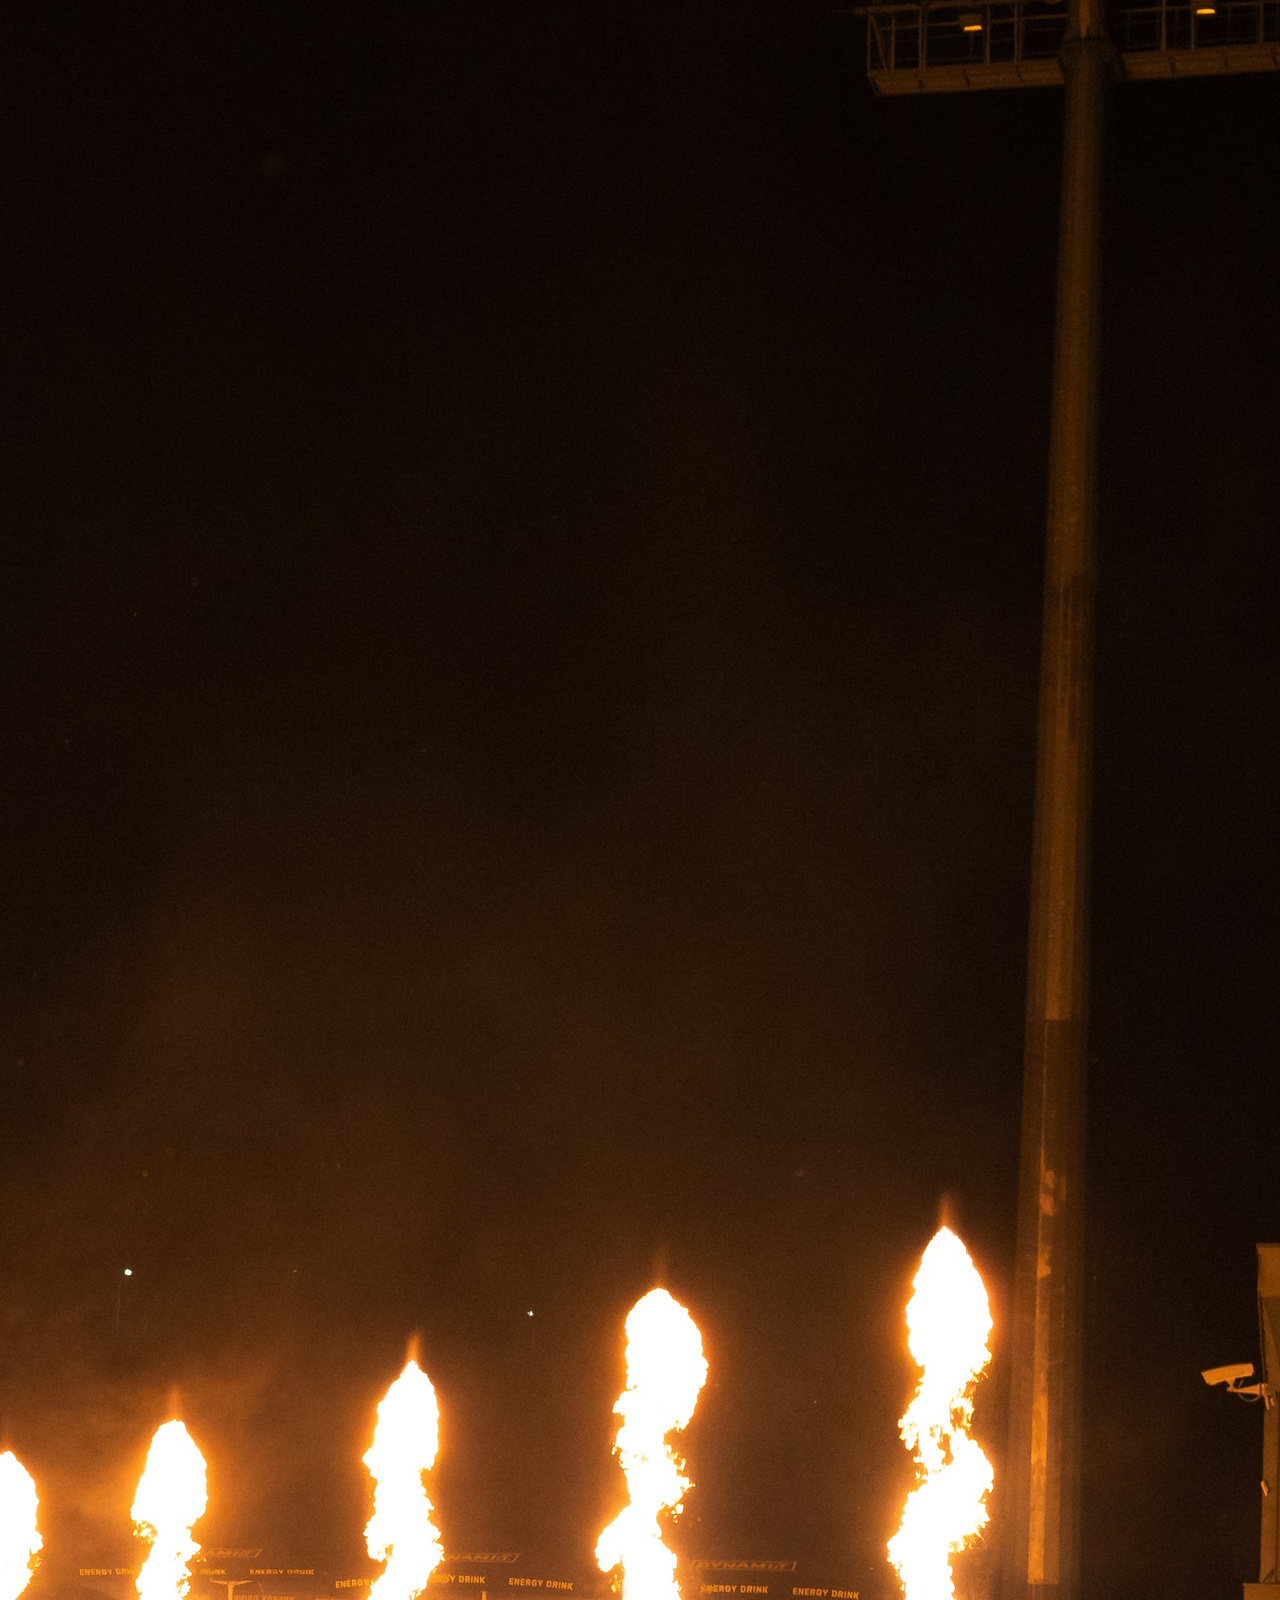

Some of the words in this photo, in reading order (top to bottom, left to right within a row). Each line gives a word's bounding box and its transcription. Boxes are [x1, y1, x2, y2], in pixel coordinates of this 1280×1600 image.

[79, 1568, 113, 1577] ENERGY
[458, 1575, 486, 1585] DRINK
[508, 1577, 544, 1588] ENERGY
[545, 1580, 575, 1591] DRINK
[740, 1585, 769, 1595] DRINK
[792, 1587, 829, 1598] ENERGY
[831, 1589, 861, 1600] DRINK
